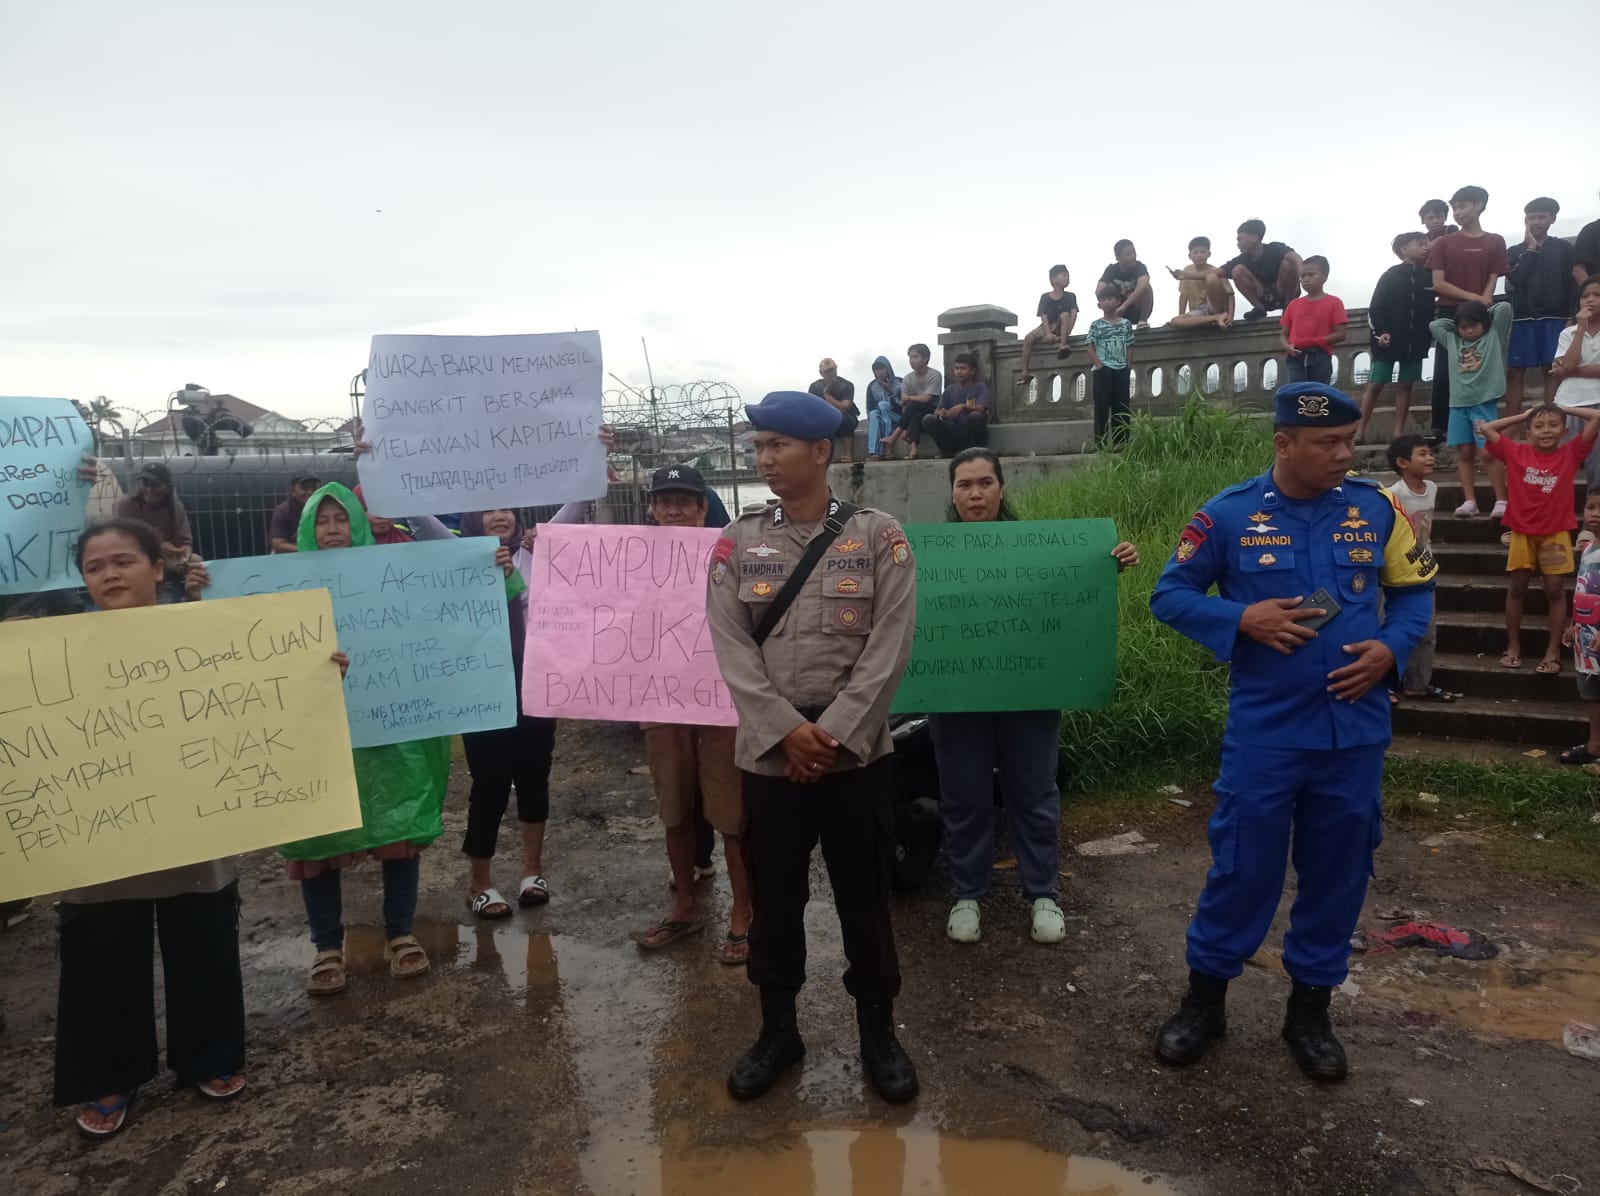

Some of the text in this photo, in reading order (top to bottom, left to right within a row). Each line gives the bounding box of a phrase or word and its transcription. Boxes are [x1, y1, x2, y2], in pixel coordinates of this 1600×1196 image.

[502, 352, 592, 374] MEMANGGIL
[374, 385, 575, 419] BANGKIT BERSAMA
[490, 416, 595, 449] KAPITALIS
[921, 534, 956, 550] FOR
[964, 533, 1003, 550] PARA
[1011, 532, 1089, 548] JURNALIS
[1240, 535, 1291, 547] SUWANDI
[1333, 532, 1378, 543] POLRI
[379, 562, 497, 593] AKTIVITAS
[742, 564, 784, 575] RAMDHAN
[827, 558, 870, 570] POLRI
[976, 567, 1007, 583] DAN
[1015, 565, 1084, 582] PEGIAT
[925, 589, 1099, 611] MEDIA YANG TELAH
[422, 601, 503, 627] SAMPAH
[960, 618, 1033, 640] BERITA
[412, 653, 504, 682] DISEGEL
[546, 672, 733, 709] BANTAR GE
[65, 697, 165, 750] YANG
[179, 675, 290, 723] DAPAT
[178, 727, 295, 770] ENAK
[0, 751, 135, 806] SAMPAH
[213, 763, 284, 792] AJA
[16, 795, 157, 862] PENYAKIT
